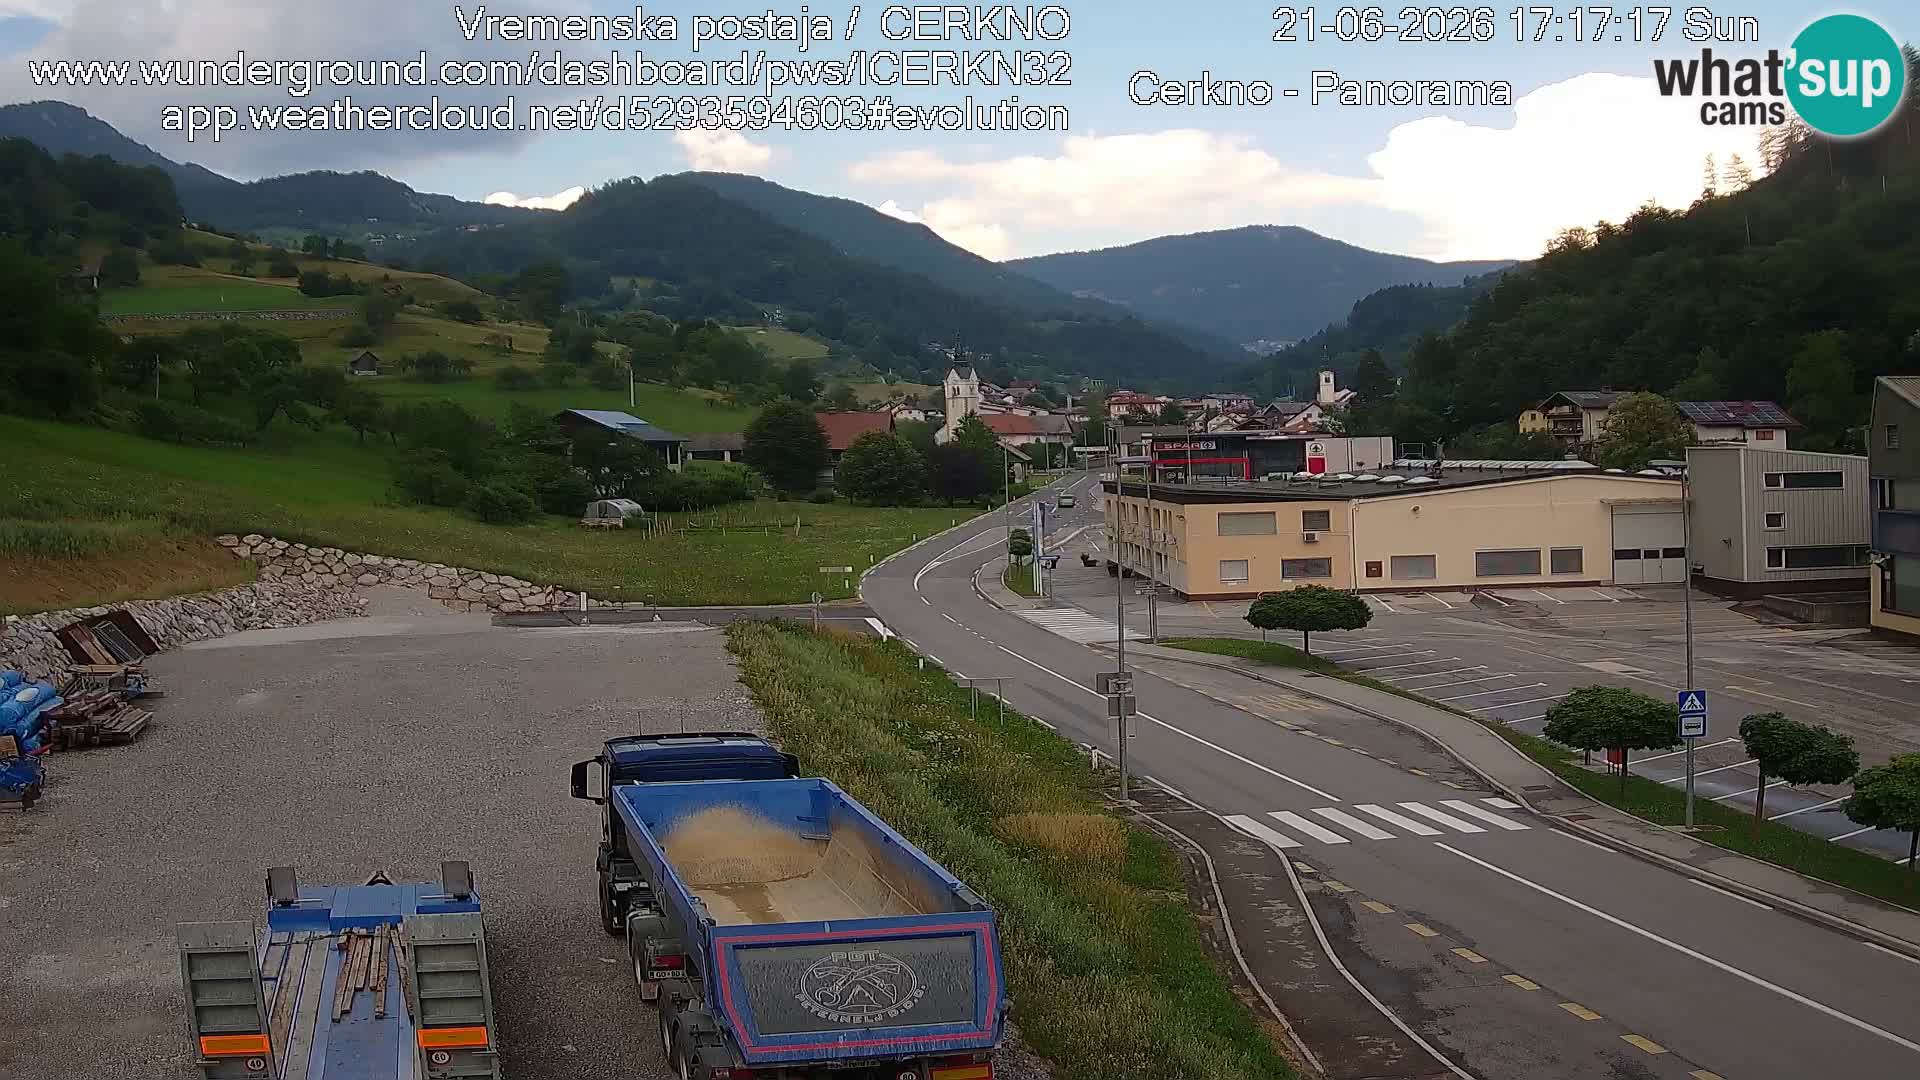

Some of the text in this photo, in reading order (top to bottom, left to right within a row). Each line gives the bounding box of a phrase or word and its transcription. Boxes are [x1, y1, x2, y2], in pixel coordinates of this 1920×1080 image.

[831, 950, 881, 963] PGT
[434, 1053, 446, 1061] 60
[250, 1060, 262, 1068] 40
